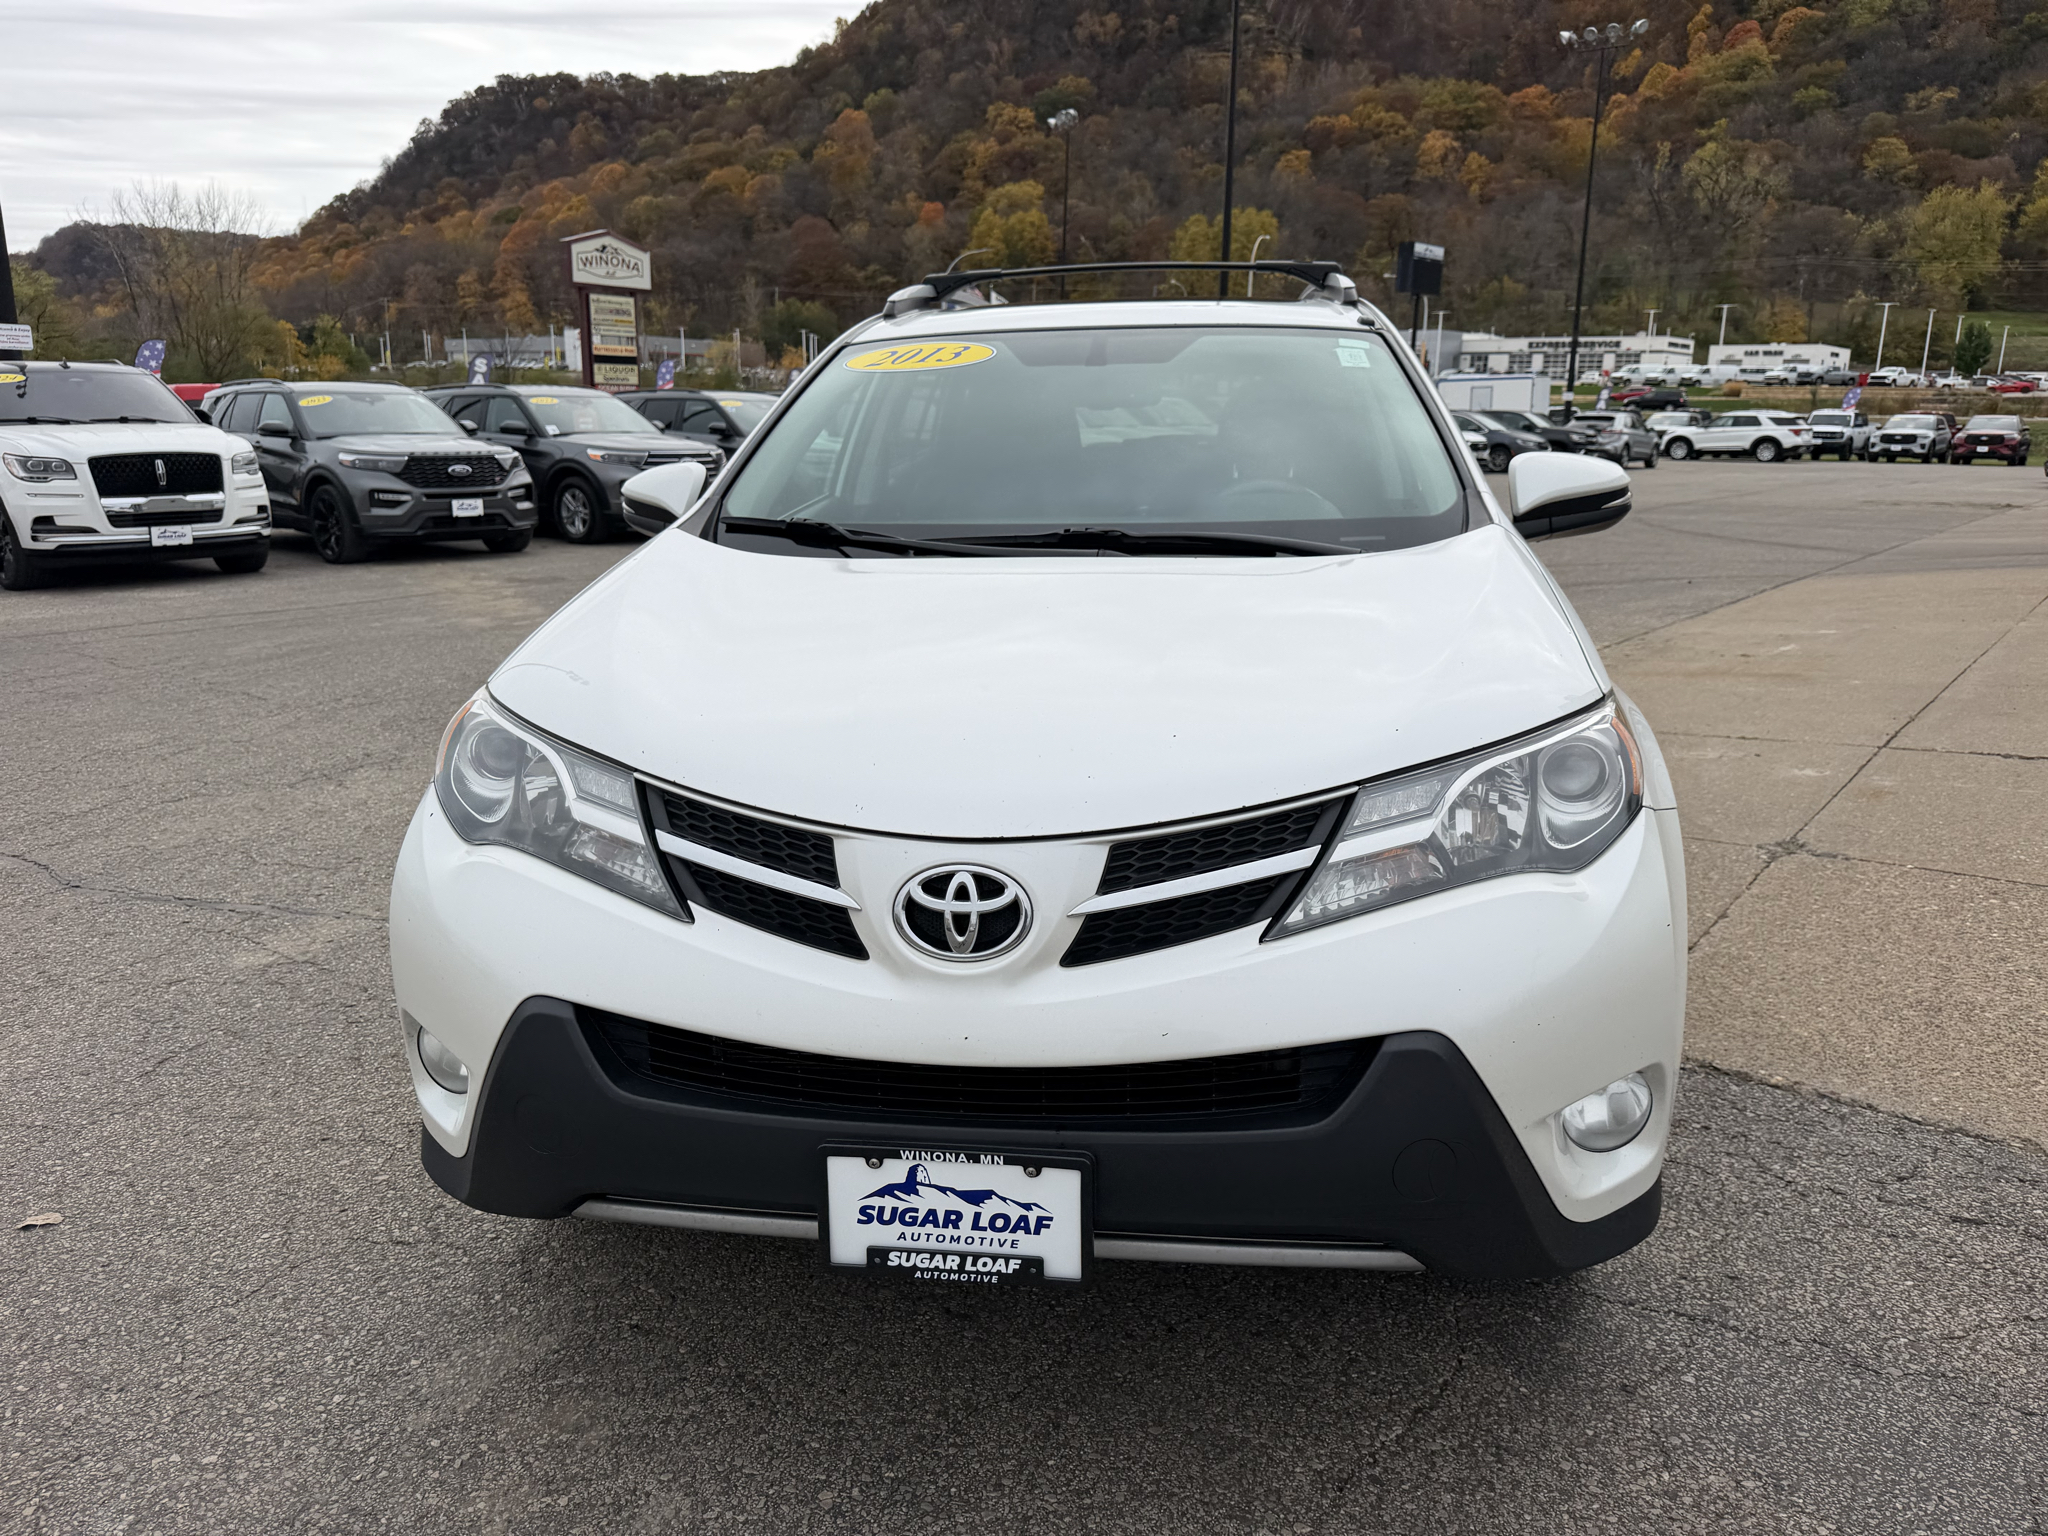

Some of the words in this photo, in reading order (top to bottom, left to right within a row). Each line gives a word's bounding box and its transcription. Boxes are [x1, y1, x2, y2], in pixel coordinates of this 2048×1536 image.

[579, 254, 641, 273] WINONA
[863, 345, 971, 368] 2013
[979, 1154, 1004, 1166] MN
[856, 1204, 963, 1231] SUGAR
[970, 1211, 1054, 1236] LOAF
[896, 1231, 1020, 1249] AUTOMOTIVE
[886, 1250, 961, 1270] SUGAR
[964, 1255, 1022, 1274] LOAF
[914, 1270, 999, 1284] AUTOMOTIVE
